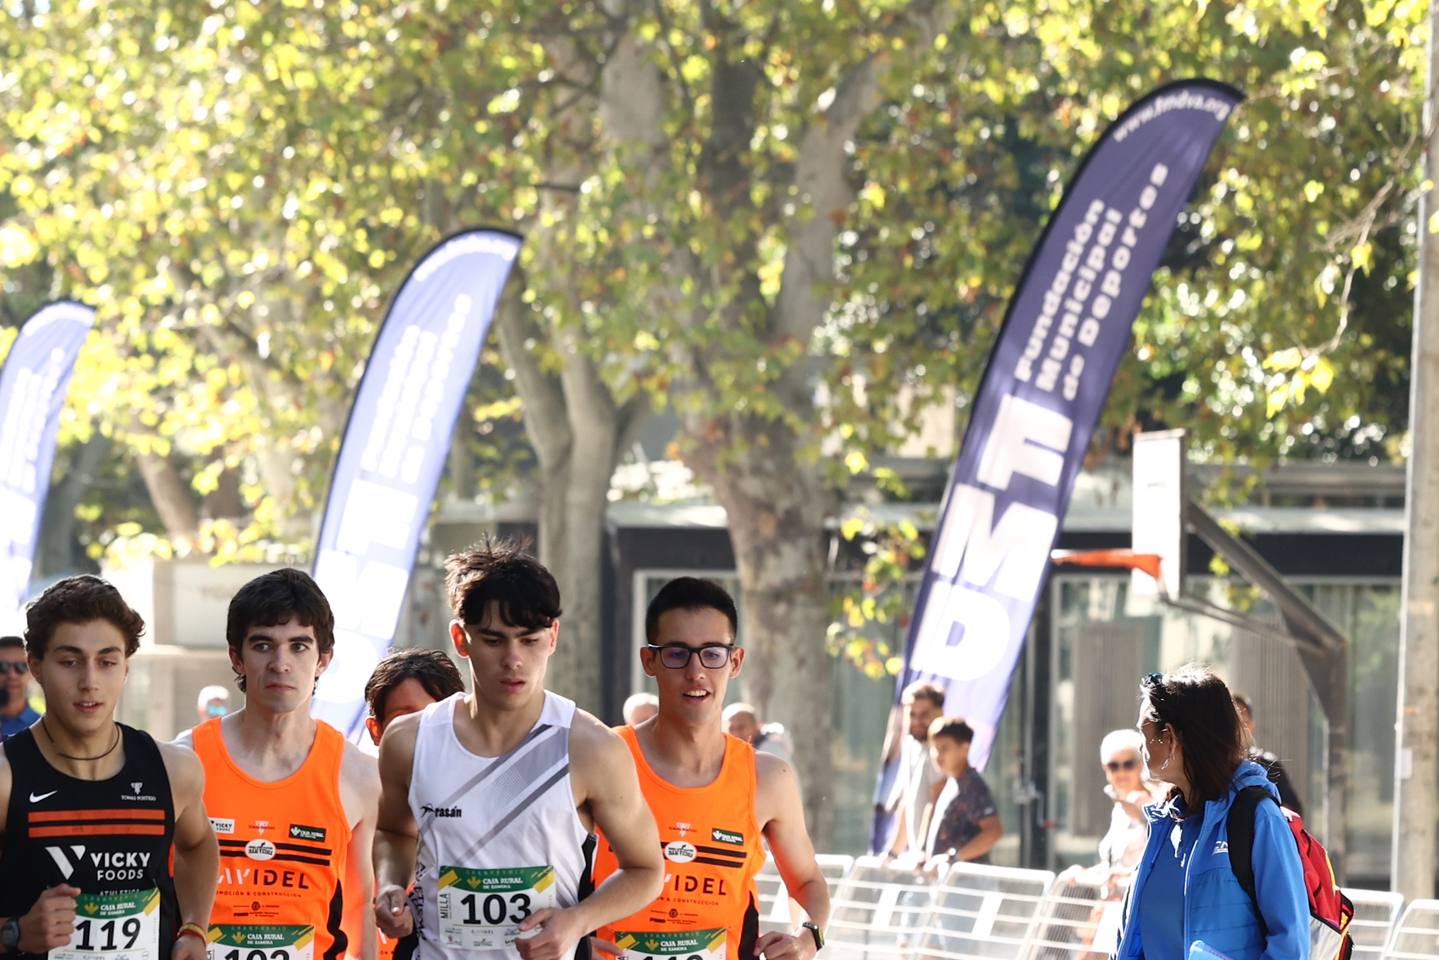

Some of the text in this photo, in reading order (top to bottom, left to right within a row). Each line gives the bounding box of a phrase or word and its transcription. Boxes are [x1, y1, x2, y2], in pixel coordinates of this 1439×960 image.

[1077, 162, 1169, 348] Deportes
[1034, 207, 1123, 393] Municipal
[90, 851, 150, 868] VICKY
[97, 868, 144, 881] FOODS
[217, 867, 309, 890] AVIDEL
[666, 873, 727, 896] IDEL
[440, 893, 449, 919] MILLA
[460, 893, 532, 925] 103
[75, 917, 141, 951] 119
